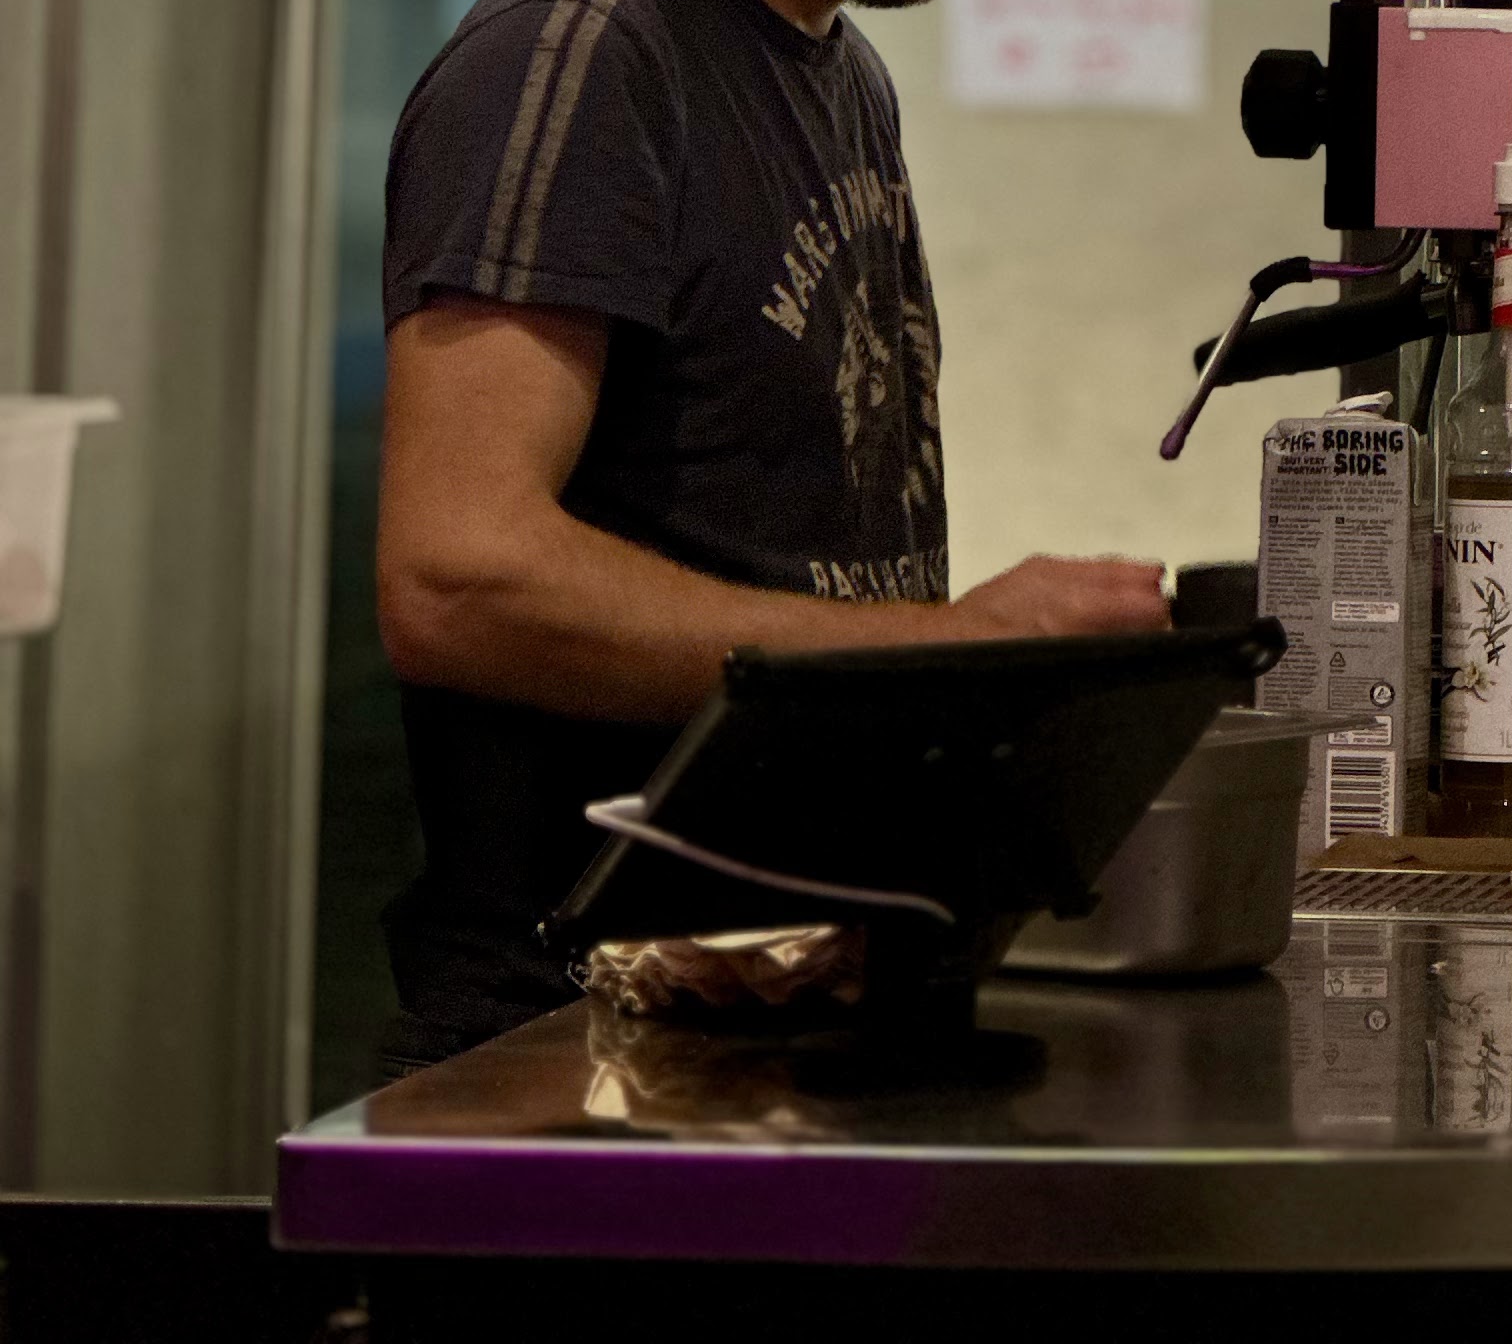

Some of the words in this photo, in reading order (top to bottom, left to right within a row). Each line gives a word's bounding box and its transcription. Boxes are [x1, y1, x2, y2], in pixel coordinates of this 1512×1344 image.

[1279, 430, 1316, 453] THE
[1322, 429, 1404, 454] BORING
[1333, 453, 1387, 476] SIDE
[1446, 540, 1497, 565] NIN
